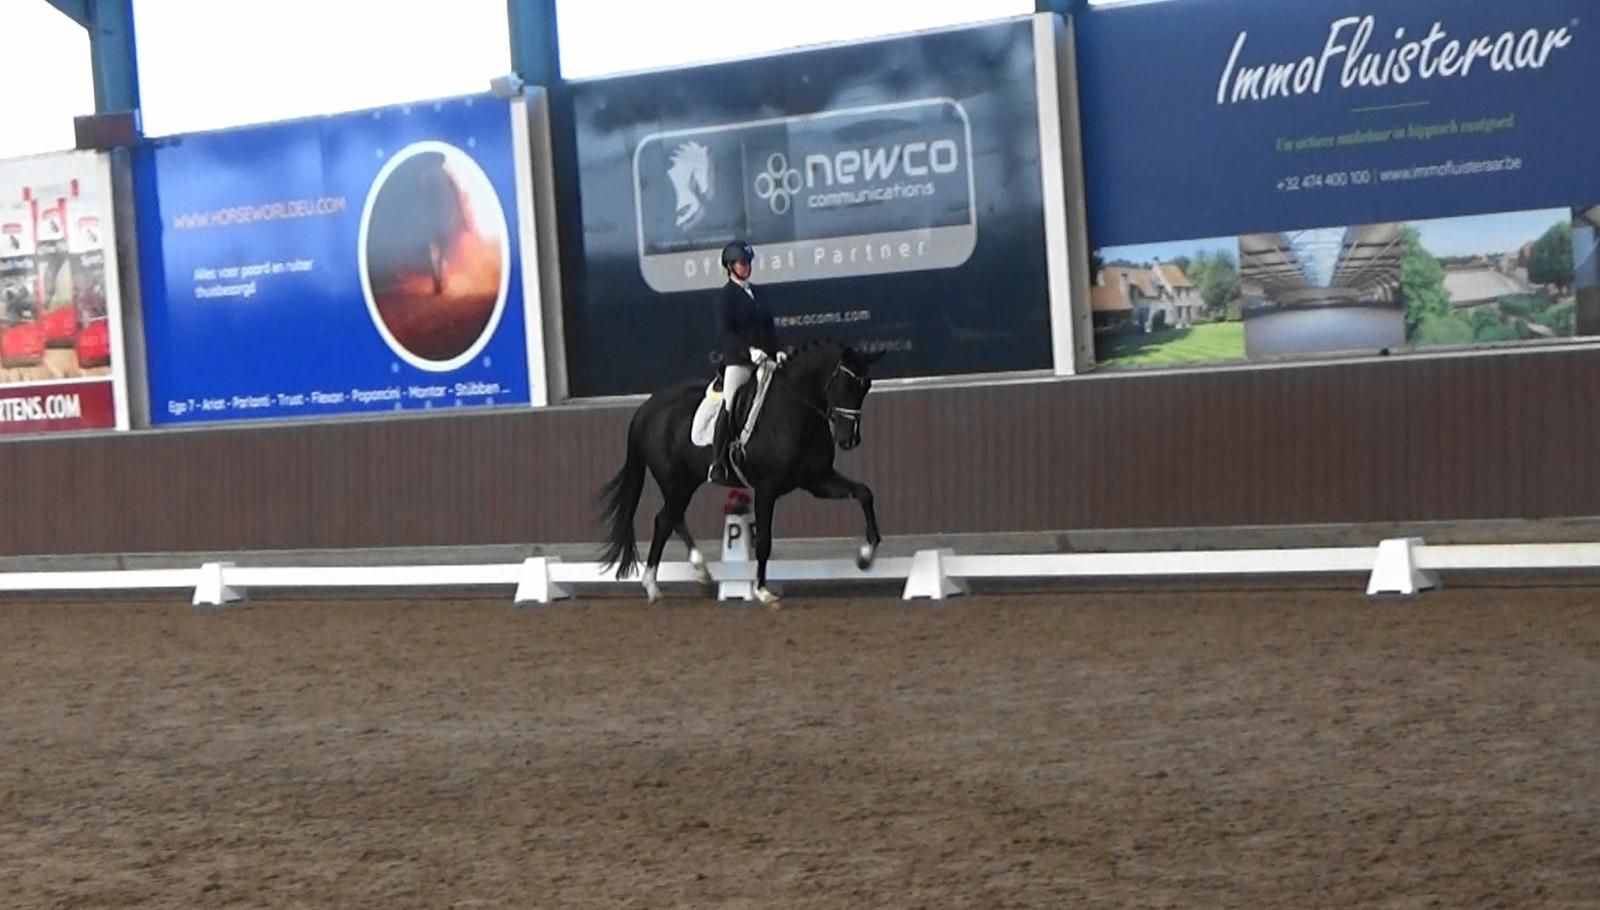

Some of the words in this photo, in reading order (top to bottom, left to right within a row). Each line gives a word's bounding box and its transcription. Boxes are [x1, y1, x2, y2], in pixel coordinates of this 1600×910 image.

[1216, 14, 1572, 105] ImmoFluisteraar
[1324, 171, 1349, 186] 400
[1349, 169, 1371, 184] 100
[808, 182, 935, 208] communications
[814, 240, 925, 266] Partner
